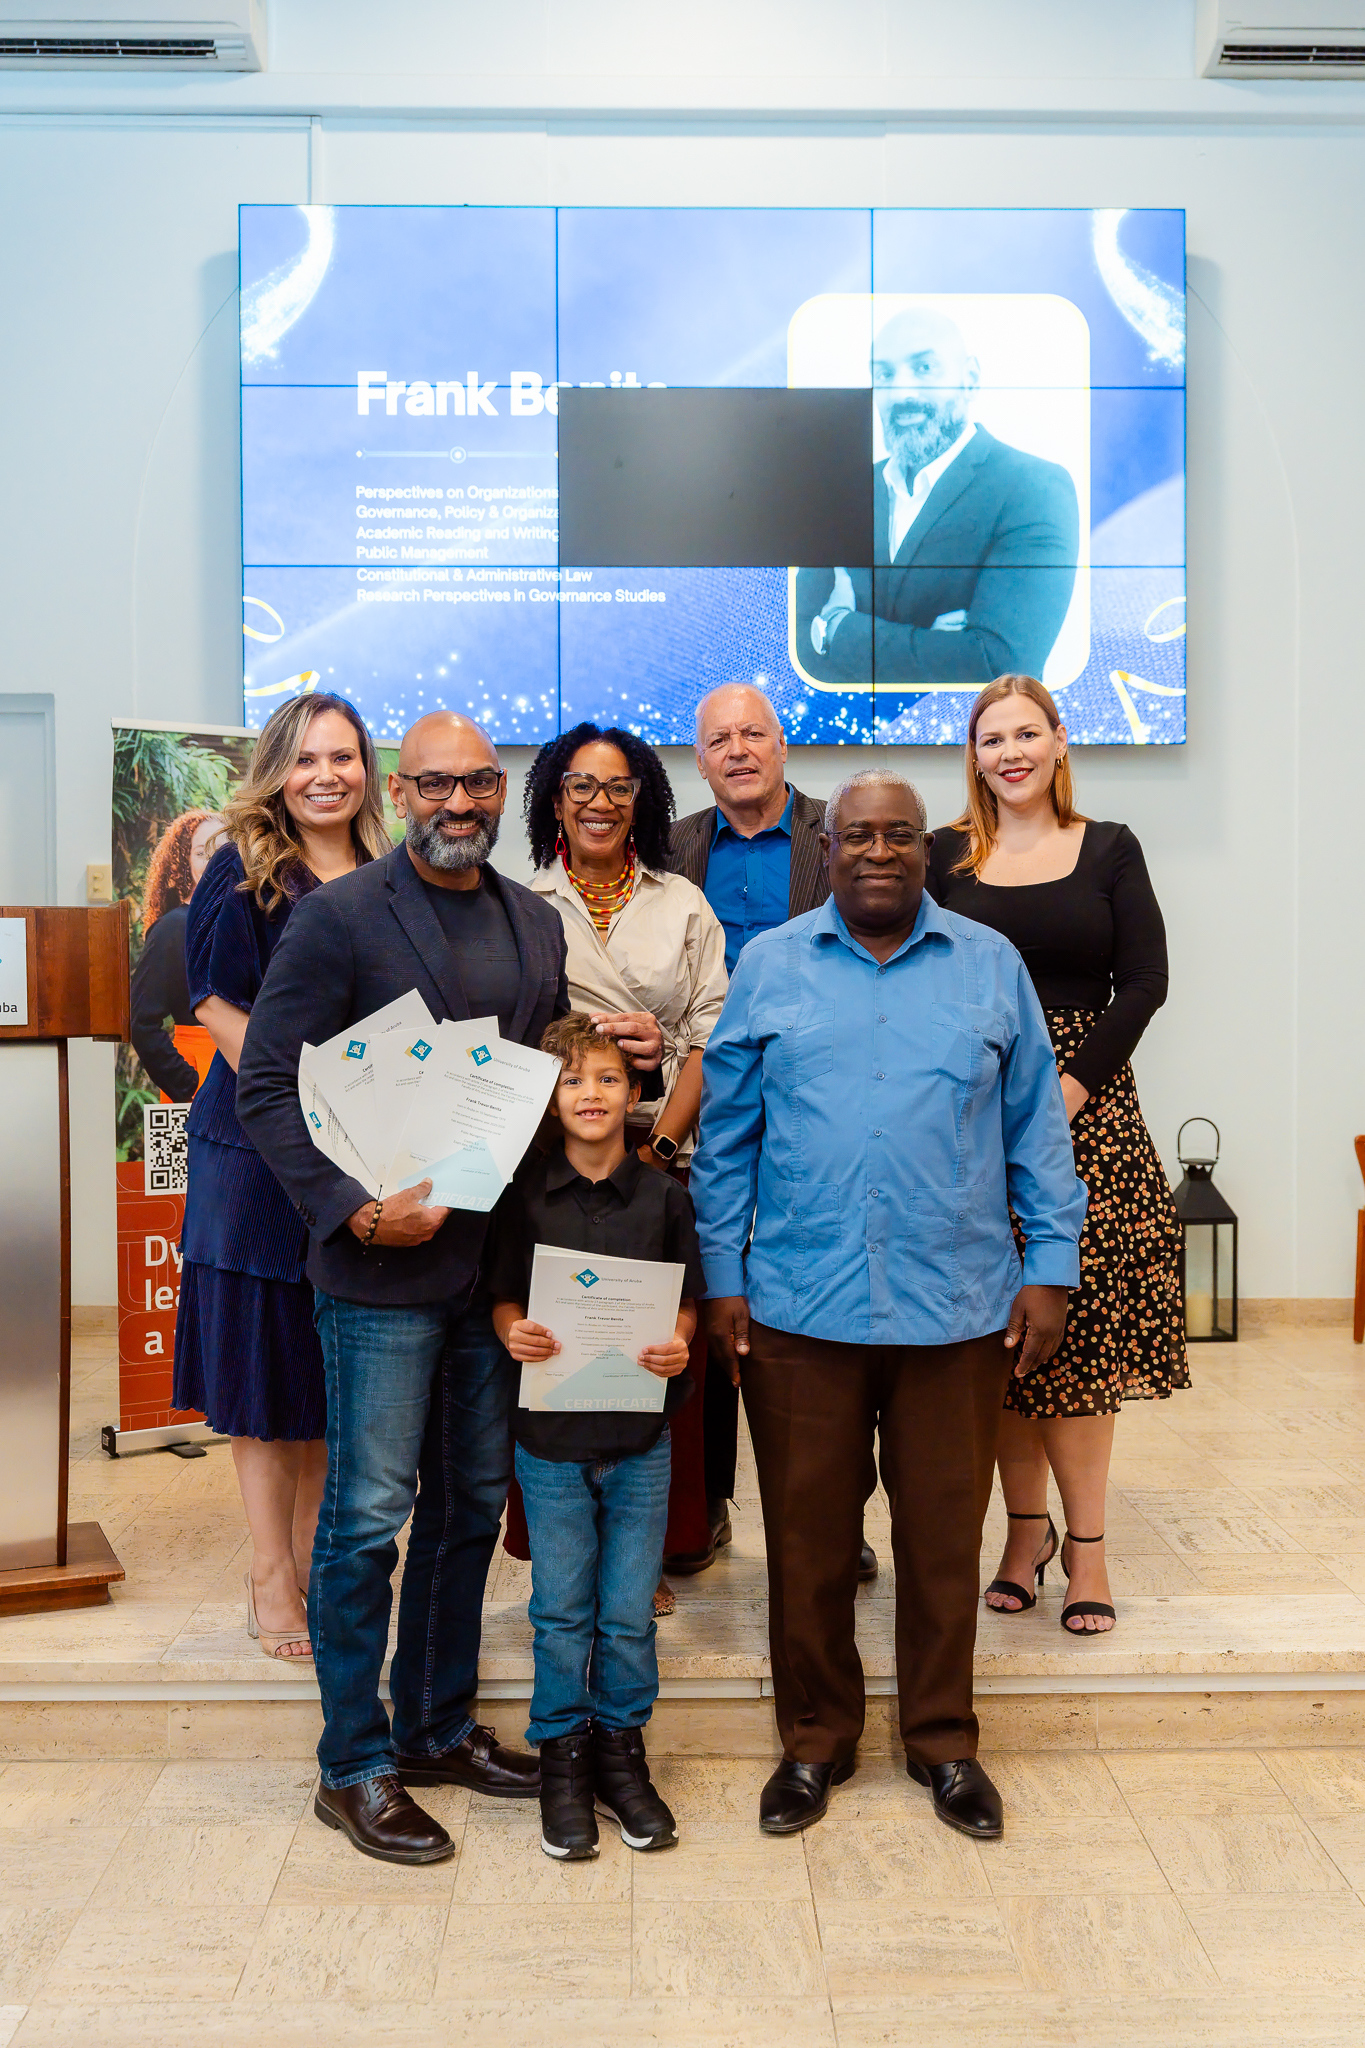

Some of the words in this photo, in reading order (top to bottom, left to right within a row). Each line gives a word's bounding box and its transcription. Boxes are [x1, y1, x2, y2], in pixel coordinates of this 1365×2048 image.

[357, 371, 499, 416] Frank
[356, 485, 444, 502] Perspectives
[446, 488, 464, 499] on
[467, 485, 559, 502] Organizations
[356, 504, 442, 521] Governance,
[444, 505, 486, 522] Policy
[489, 505, 500, 519] &
[355, 525, 424, 540] Academic
[426, 525, 481, 542] Reading
[484, 526, 510, 540] and
[512, 526, 559, 542] Writing
[356, 545, 398, 559] Public
[401, 545, 489, 562] Management
[356, 567, 450, 582] Constitutional
[453, 568, 464, 582] &
[466, 568, 562, 582] Administrative
[565, 568, 593, 582] Law
[356, 588, 420, 602] Research
[423, 588, 511, 605] Perspectives
[514, 588, 526, 602] in
[528, 588, 612, 603] Governance
[615, 589, 666, 603] Studies
[493, 1057, 513, 1068] University
[518, 1065, 531, 1073] Aruba
[144, 1329, 165, 1355] a
[564, 1397, 658, 1409] CERTIFICATE
